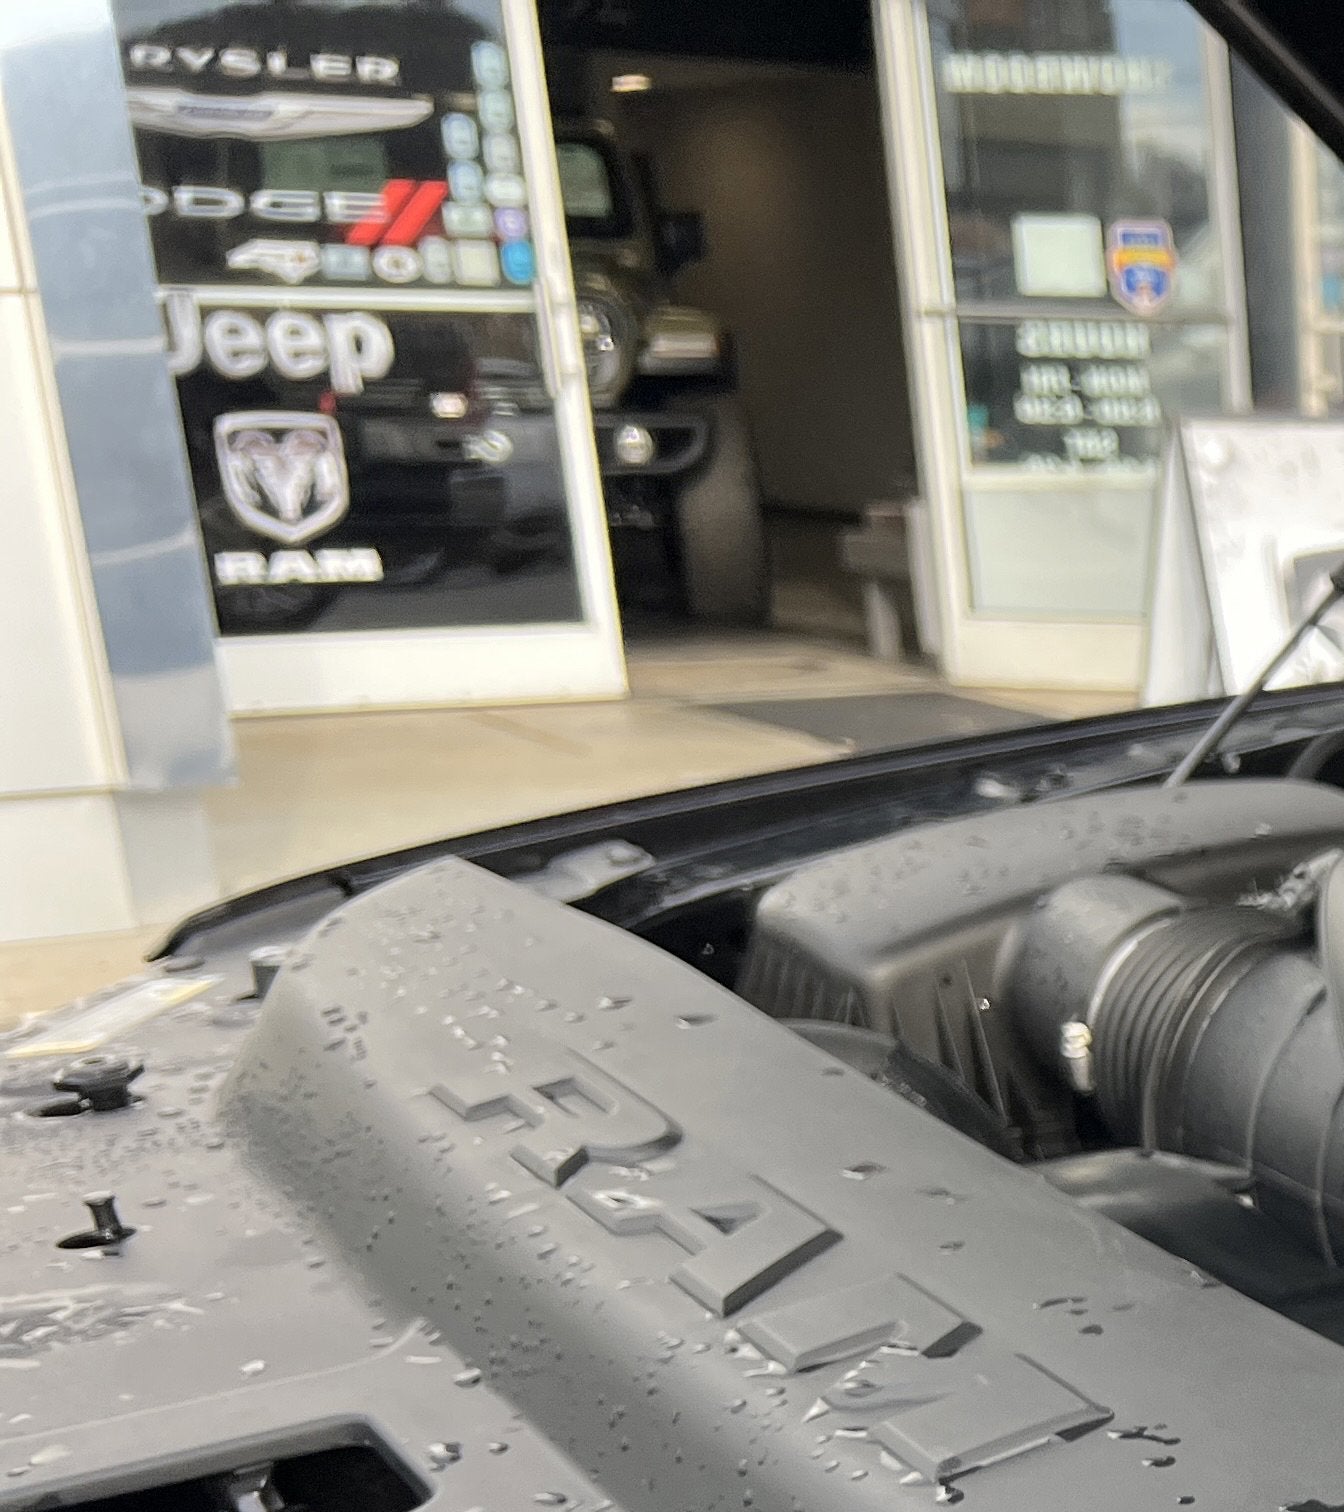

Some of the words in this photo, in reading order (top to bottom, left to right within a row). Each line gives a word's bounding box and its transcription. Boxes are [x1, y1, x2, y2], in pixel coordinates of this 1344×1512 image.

[129, 44, 400, 85] RYSLER
[165, 293, 395, 395] Jeep
[214, 548, 384, 586] RAM
[424, 1045, 1114, 1482] RAM
